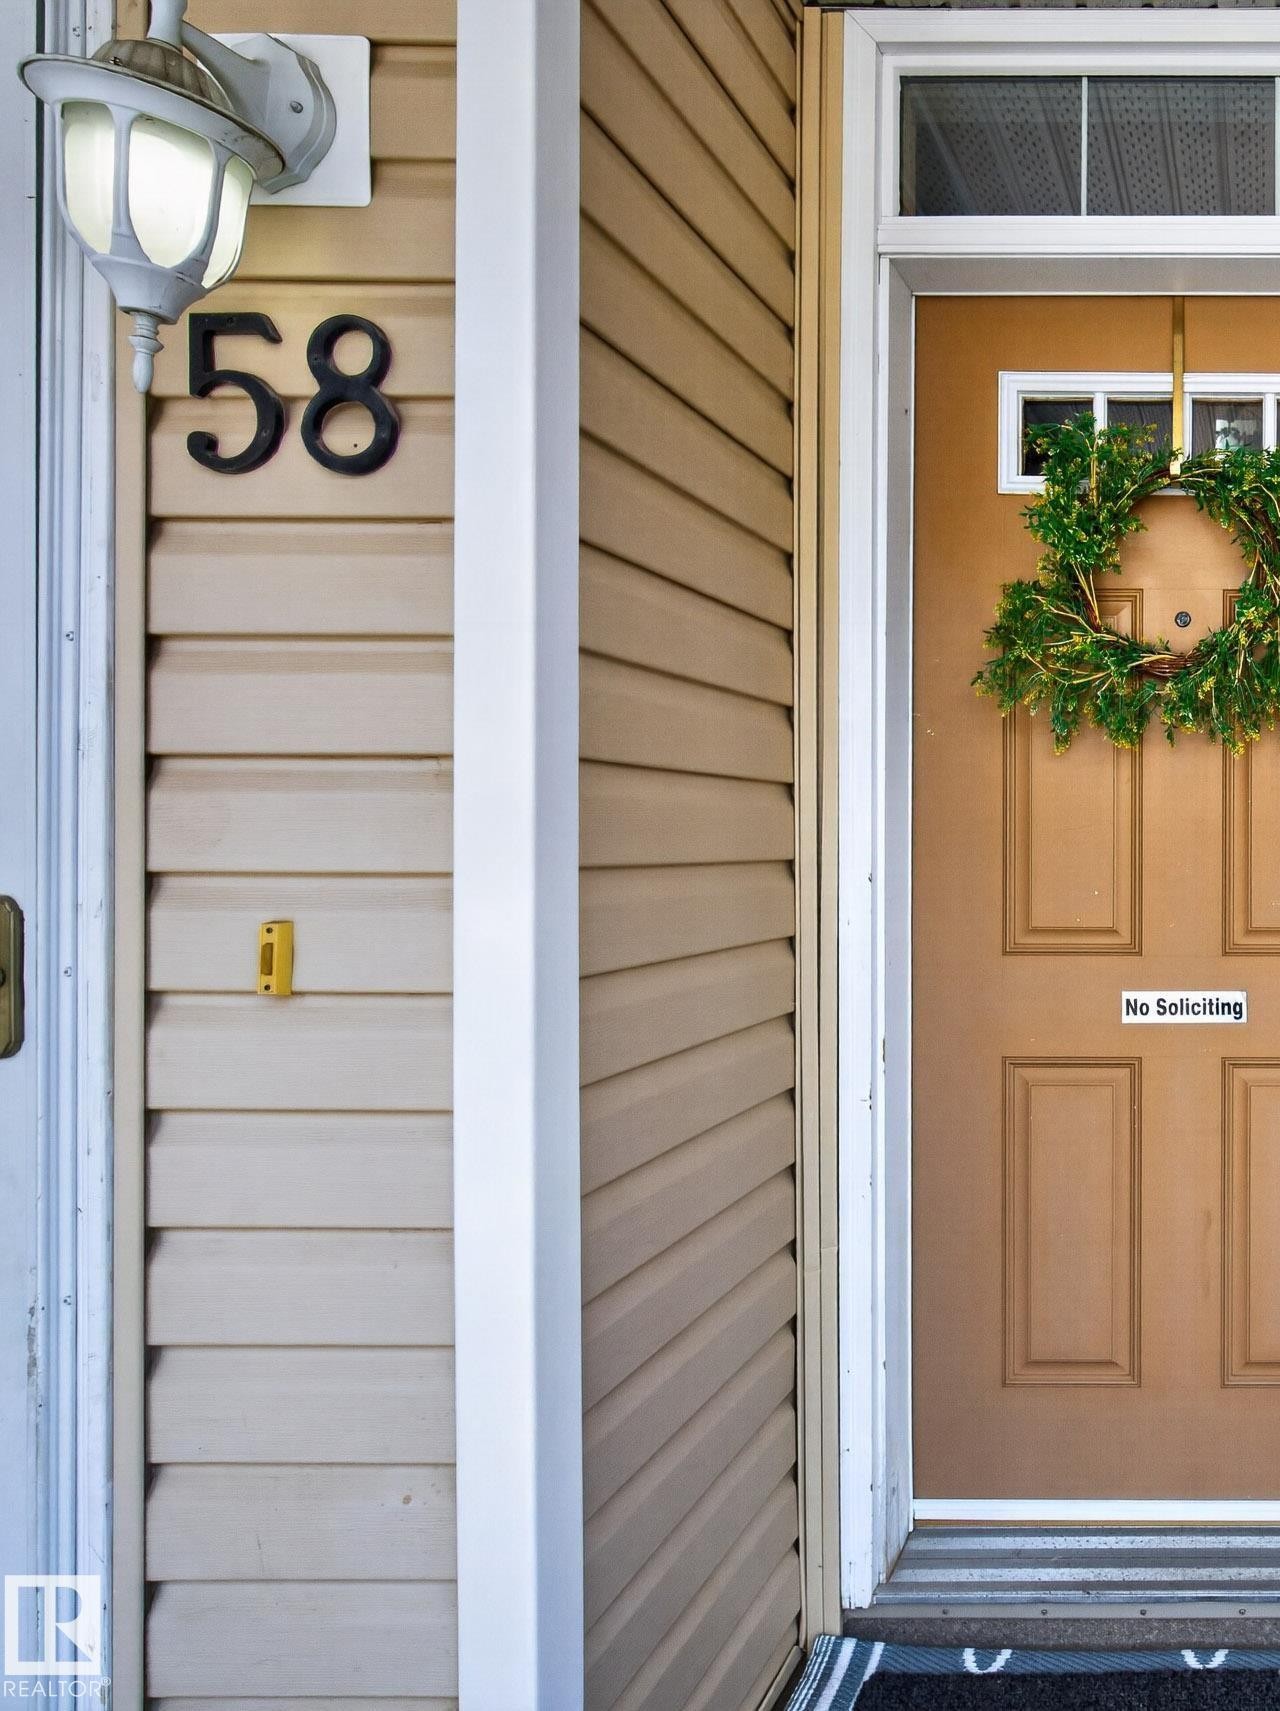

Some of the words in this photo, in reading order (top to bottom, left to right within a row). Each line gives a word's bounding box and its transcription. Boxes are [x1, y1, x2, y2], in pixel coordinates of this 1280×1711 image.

[187, 312, 402, 476] 58
[1125, 998, 1150, 1016] No
[1156, 997, 1243, 1020] Soliciting
